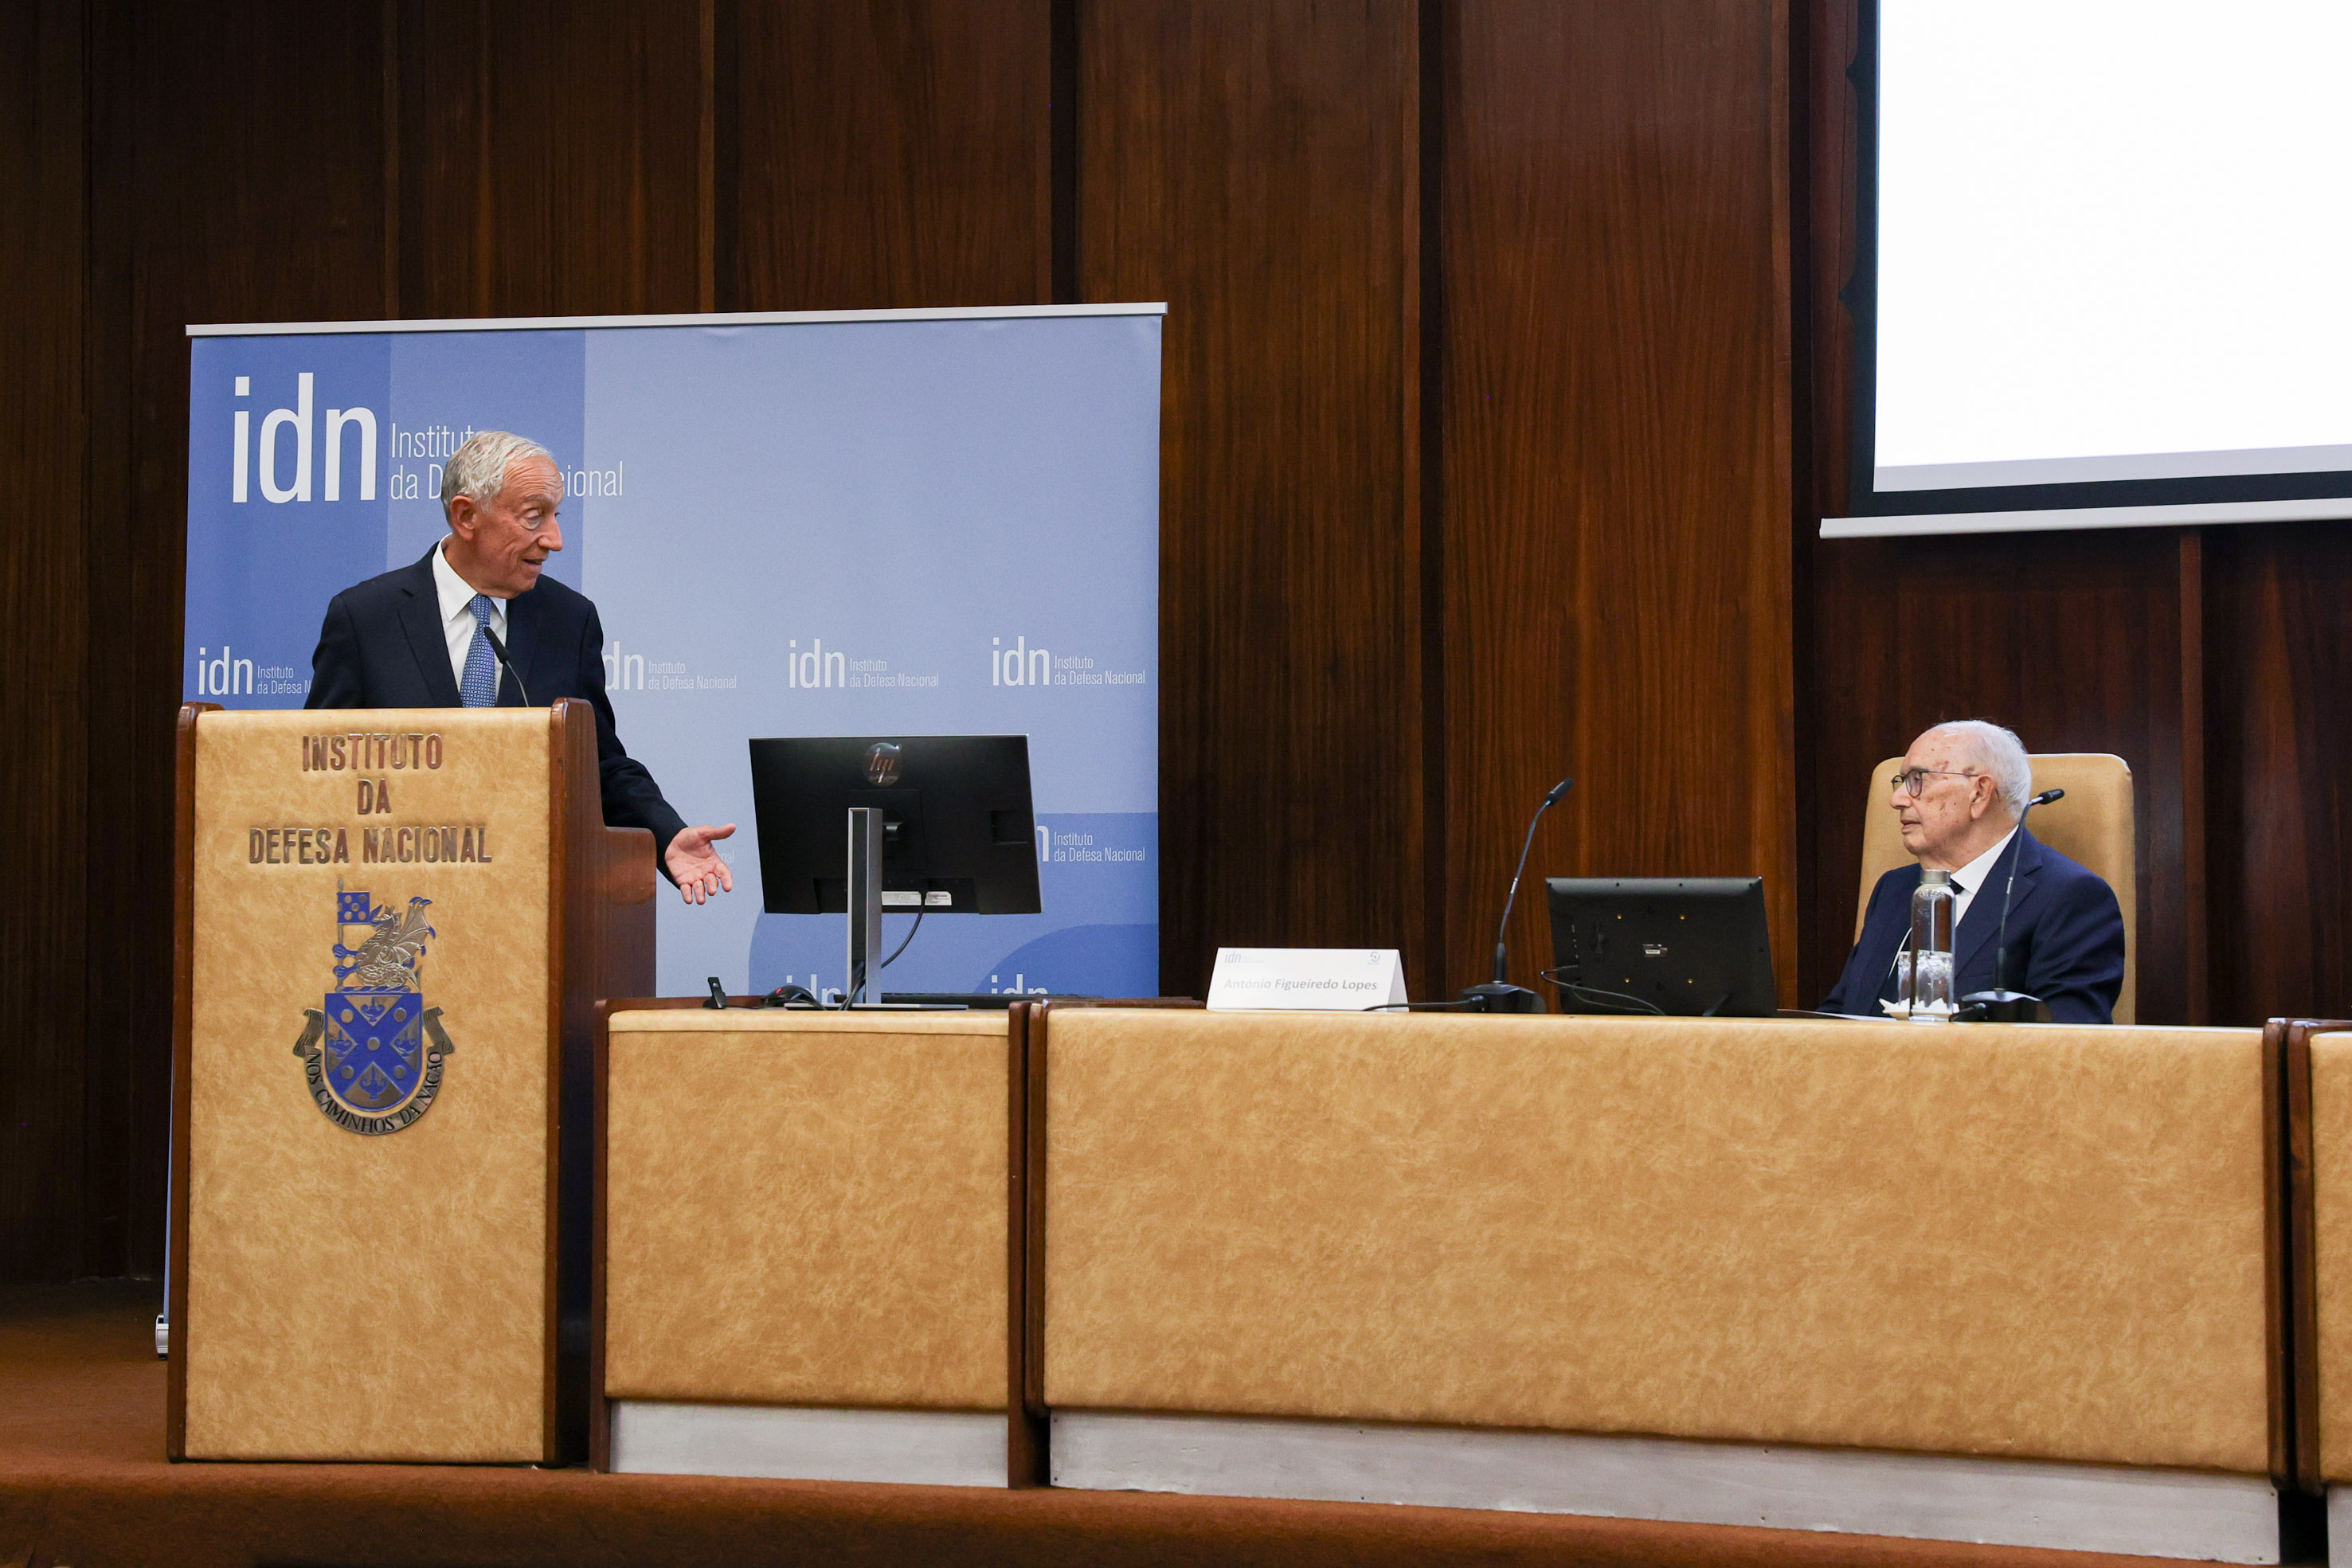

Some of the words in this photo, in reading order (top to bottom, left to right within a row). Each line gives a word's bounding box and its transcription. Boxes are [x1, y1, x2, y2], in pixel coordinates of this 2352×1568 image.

[233, 372, 377, 504] idn
[390, 465, 419, 499] da
[602, 641, 644, 690] dn
[648, 660, 686, 674] Instituto
[789, 639, 845, 688] idn
[850, 659, 886, 671] Instituto
[992, 635, 1050, 686] idn
[1055, 655, 1094, 669] Instituto
[198, 646, 253, 695] idn
[257, 665, 294, 678] Instituto
[1055, 671, 1066, 685] da
[1070, 671, 1102, 685] Defesa
[1105, 670, 1145, 684] Nacional
[257, 682, 268, 694] da
[271, 680, 302, 694] Defesa
[648, 678, 659, 690] da
[663, 675, 694, 690] Defesa
[696, 675, 737, 689] Nacional
[849, 675, 861, 688] da
[864, 674, 895, 687] Defesa
[898, 672, 939, 686] Nacional
[303, 733, 443, 771] INSTITUTO
[358, 778, 392, 814] DA
[249, 827, 350, 864] DEFESA
[363, 826, 492, 862] NACIONAL
[1054, 831, 1093, 845] Instituto
[1054, 848, 1066, 861] da
[1069, 847, 1102, 861] Defesa
[1105, 847, 1145, 861] Nacional
[1223, 979, 1271, 990] António
[1274, 979, 1339, 991] Figueiredo
[1342, 980, 1378, 991] Lopes
[306, 1053, 323, 1085] NOS
[315, 1089, 396, 1134] CAMINHOS
[401, 1106, 421, 1125] DA
